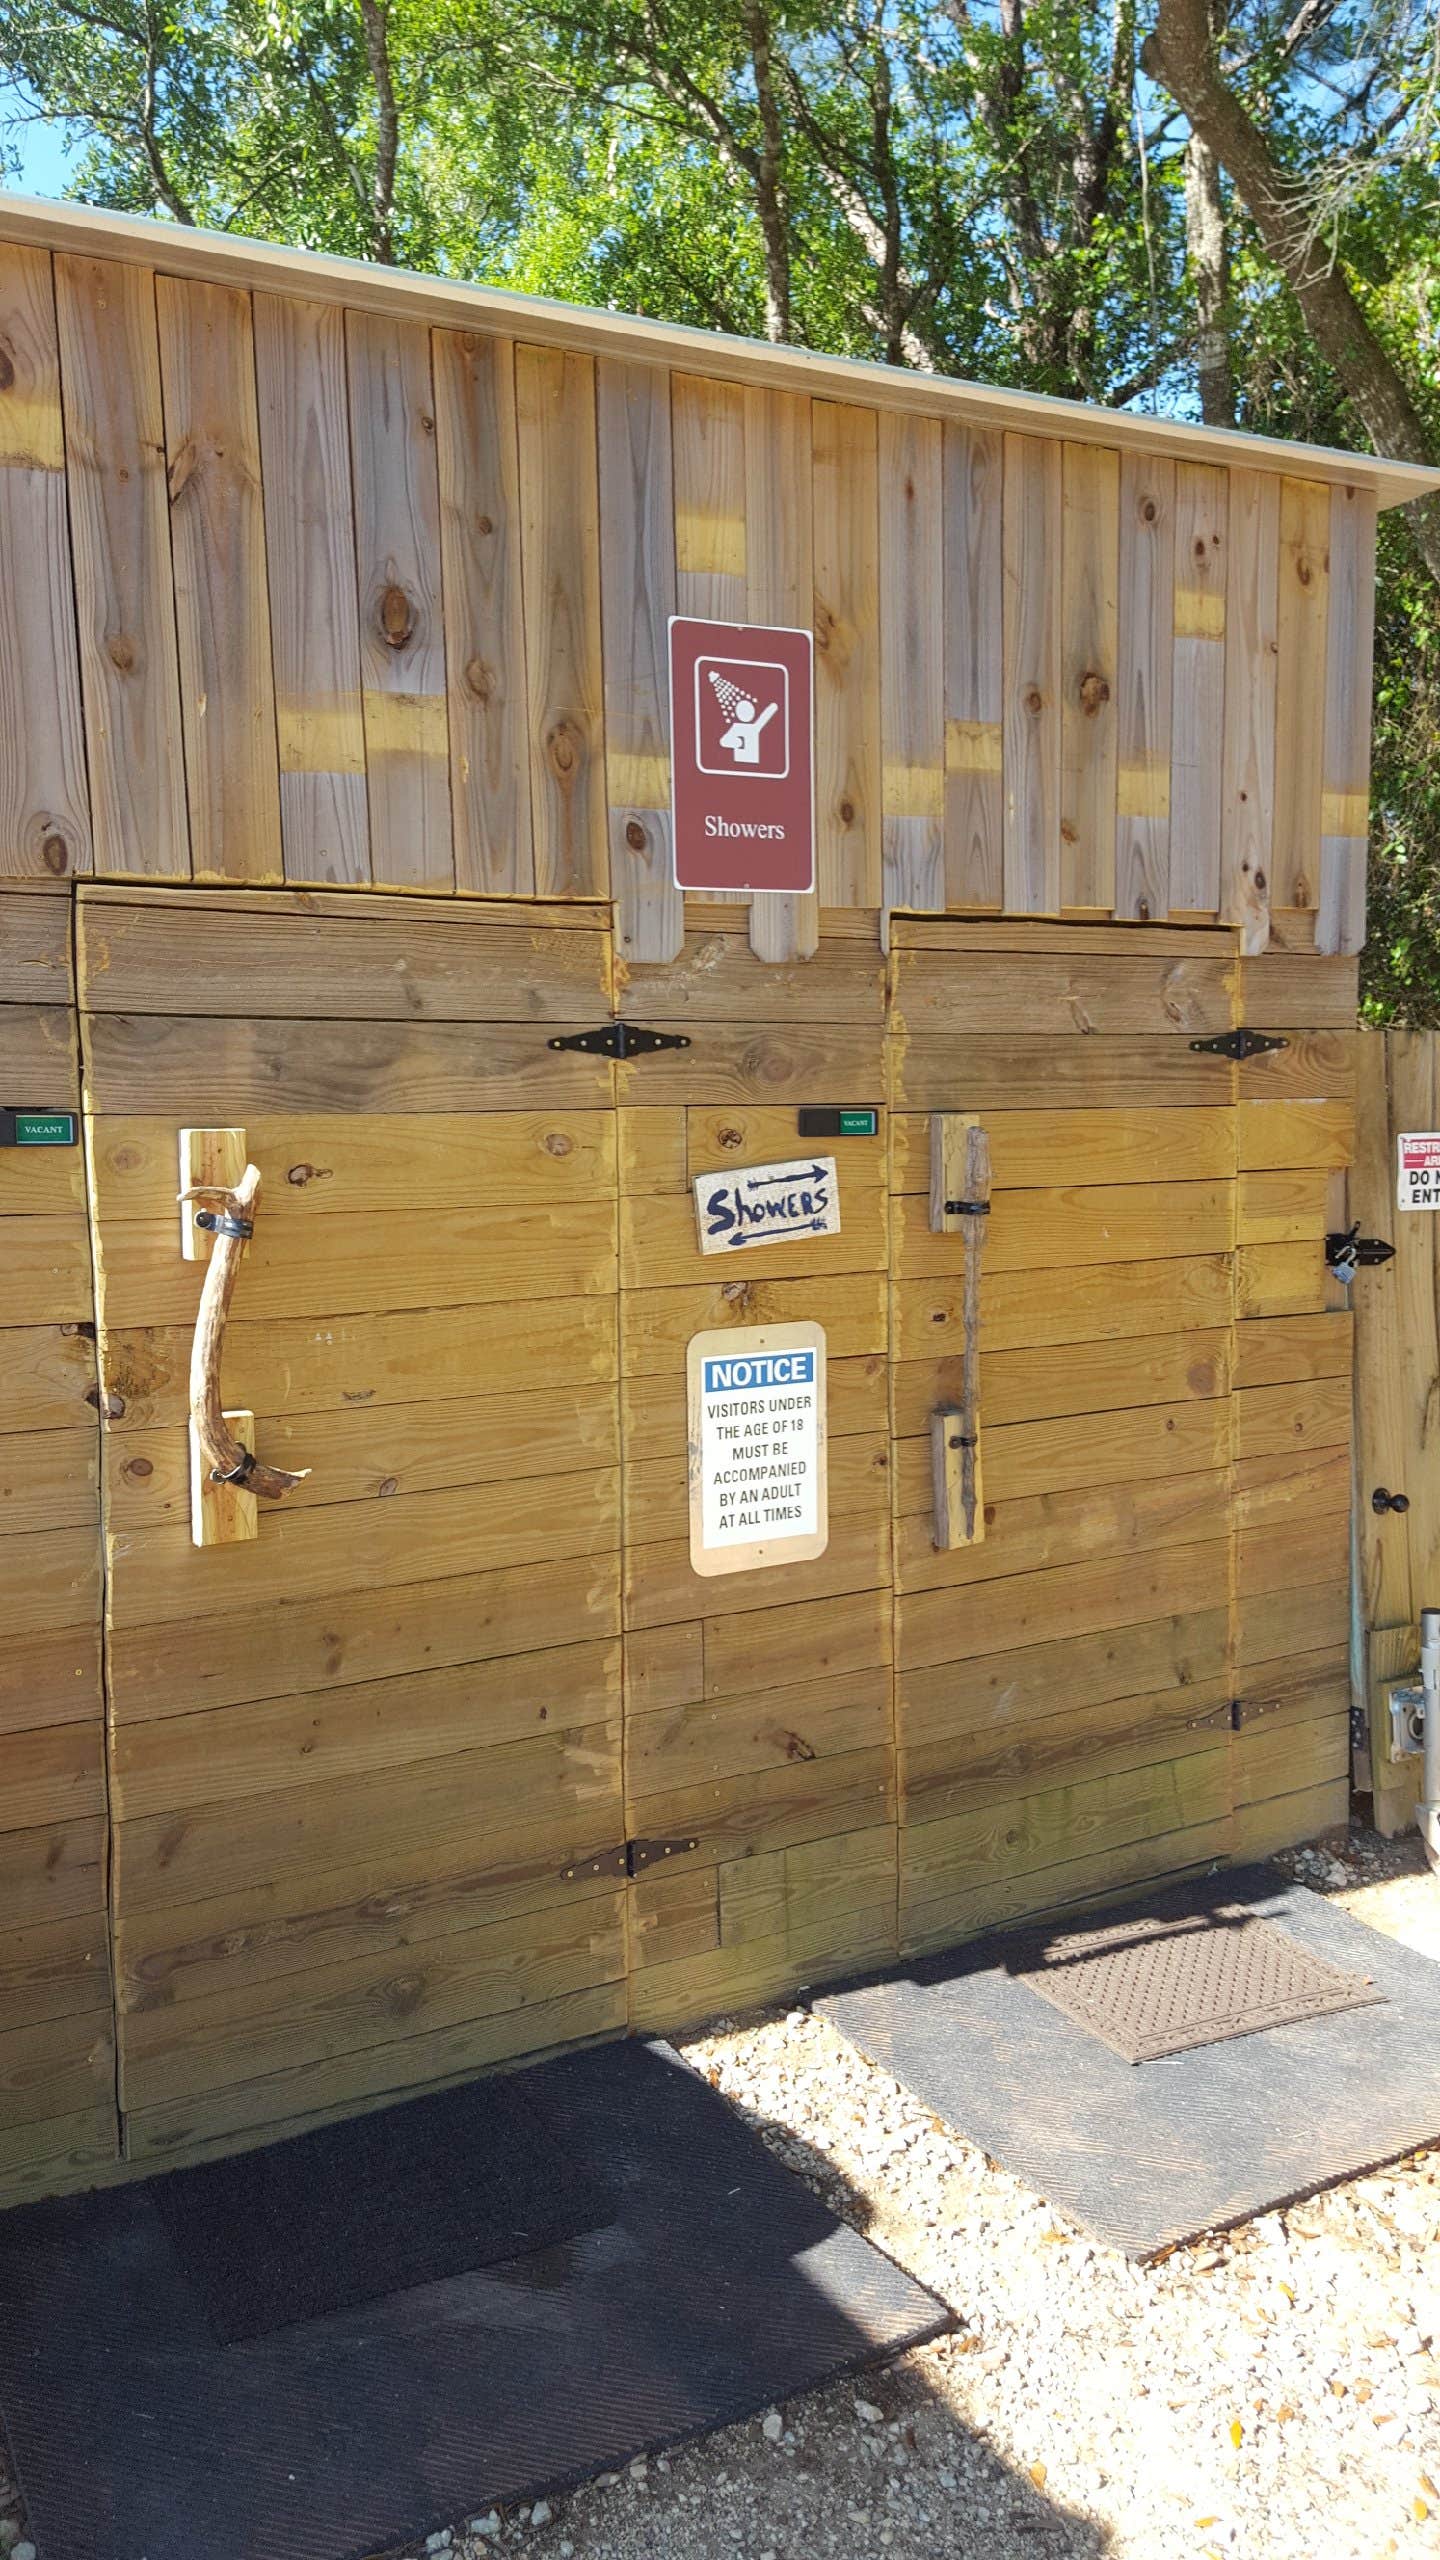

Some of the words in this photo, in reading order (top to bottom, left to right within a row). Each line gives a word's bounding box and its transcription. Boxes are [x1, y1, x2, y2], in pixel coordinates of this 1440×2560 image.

[704, 815, 786, 840] Showers
[24, 1126, 64, 1134] VACANT
[1410, 1170, 1429, 1185] DO
[711, 1356, 807, 1389] NOTICE
[707, 1400, 765, 1419] VISITORS
[769, 1396, 812, 1412] UNDER
[716, 1425, 741, 1440] THE
[744, 1422, 769, 1437] AGE
[772, 1420, 788, 1433] OF
[791, 1418, 804, 1431] 18
[732, 1444, 769, 1460] MUST
[772, 1441, 788, 1456] BE
[713, 1461, 806, 1485] ACCOMPANIED
[719, 1491, 736, 1507] BY
[739, 1489, 759, 1504] AN
[761, 1483, 802, 1501] ADULT
[719, 1514, 735, 1529] AT
[738, 1511, 761, 1526] ALL
[763, 1505, 803, 1522] TIMES
